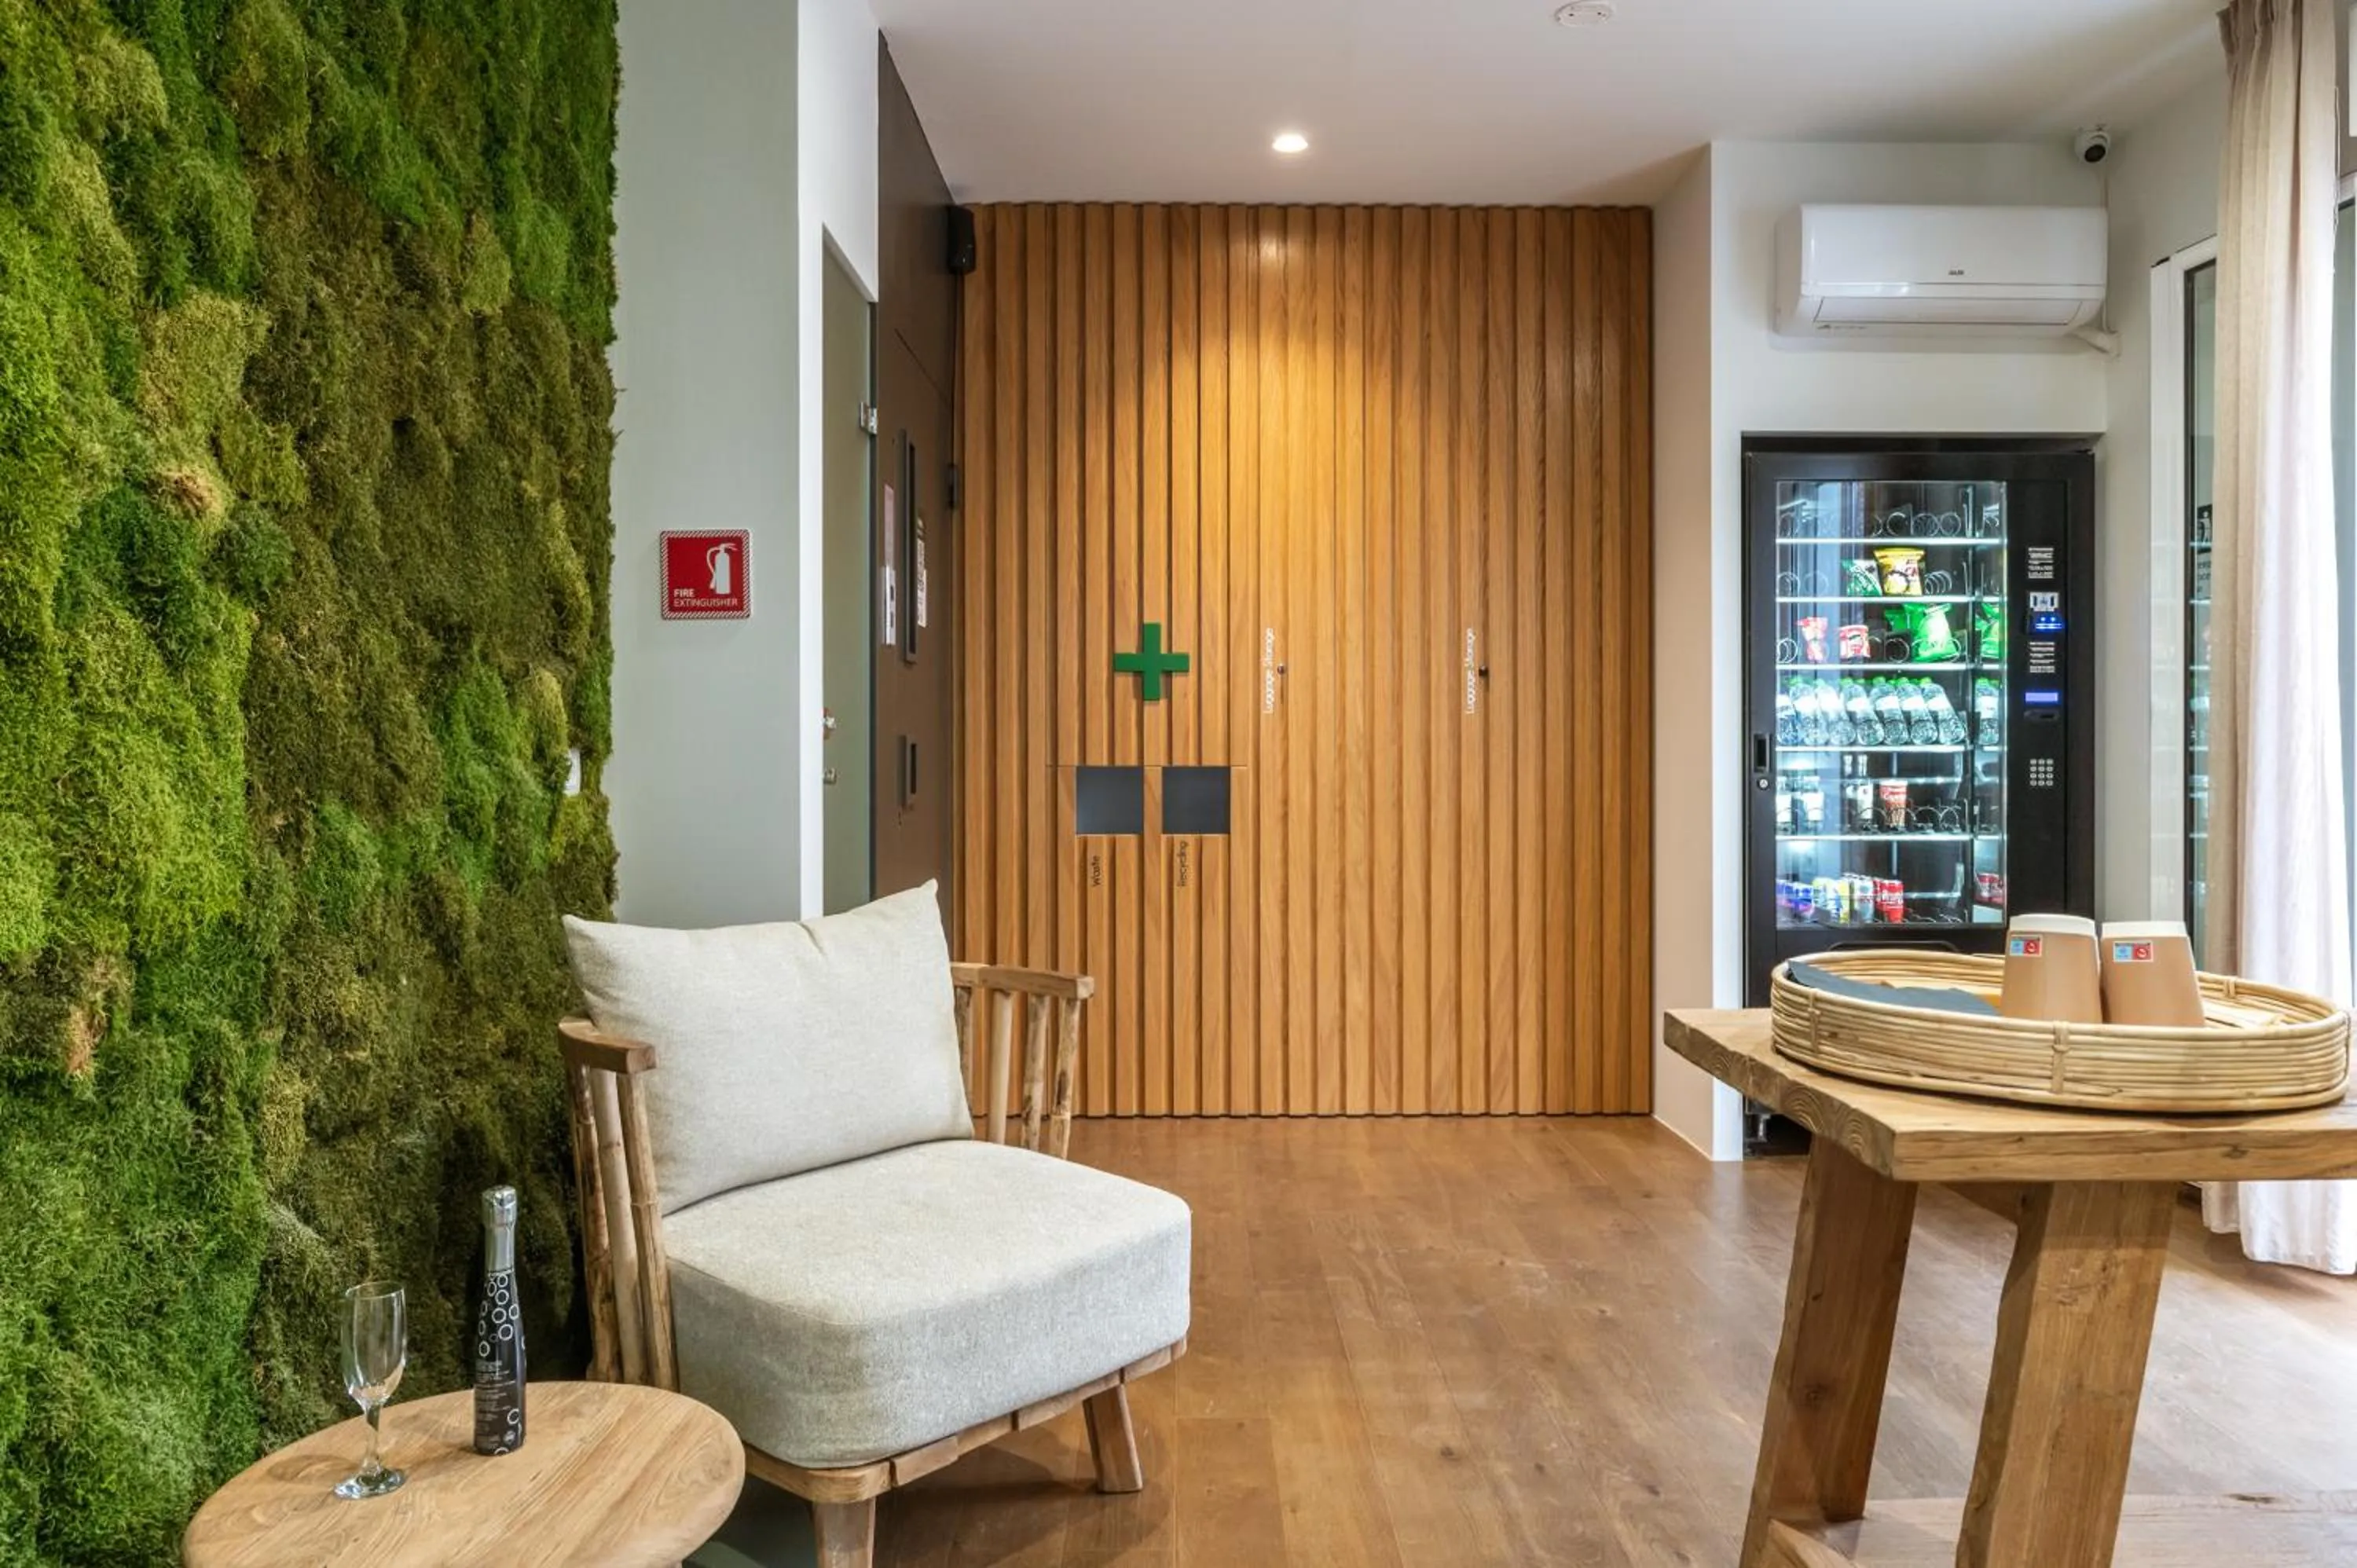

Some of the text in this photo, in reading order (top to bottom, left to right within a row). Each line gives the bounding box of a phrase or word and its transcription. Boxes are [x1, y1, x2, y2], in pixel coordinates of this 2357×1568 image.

[673, 588, 695, 597] FIRE
[673, 598, 739, 607] EXTINGUISHER
[1263, 669, 1274, 714] Luggage
[1464, 669, 1475, 714] Luggage
[1092, 855, 1101, 887] Waste
